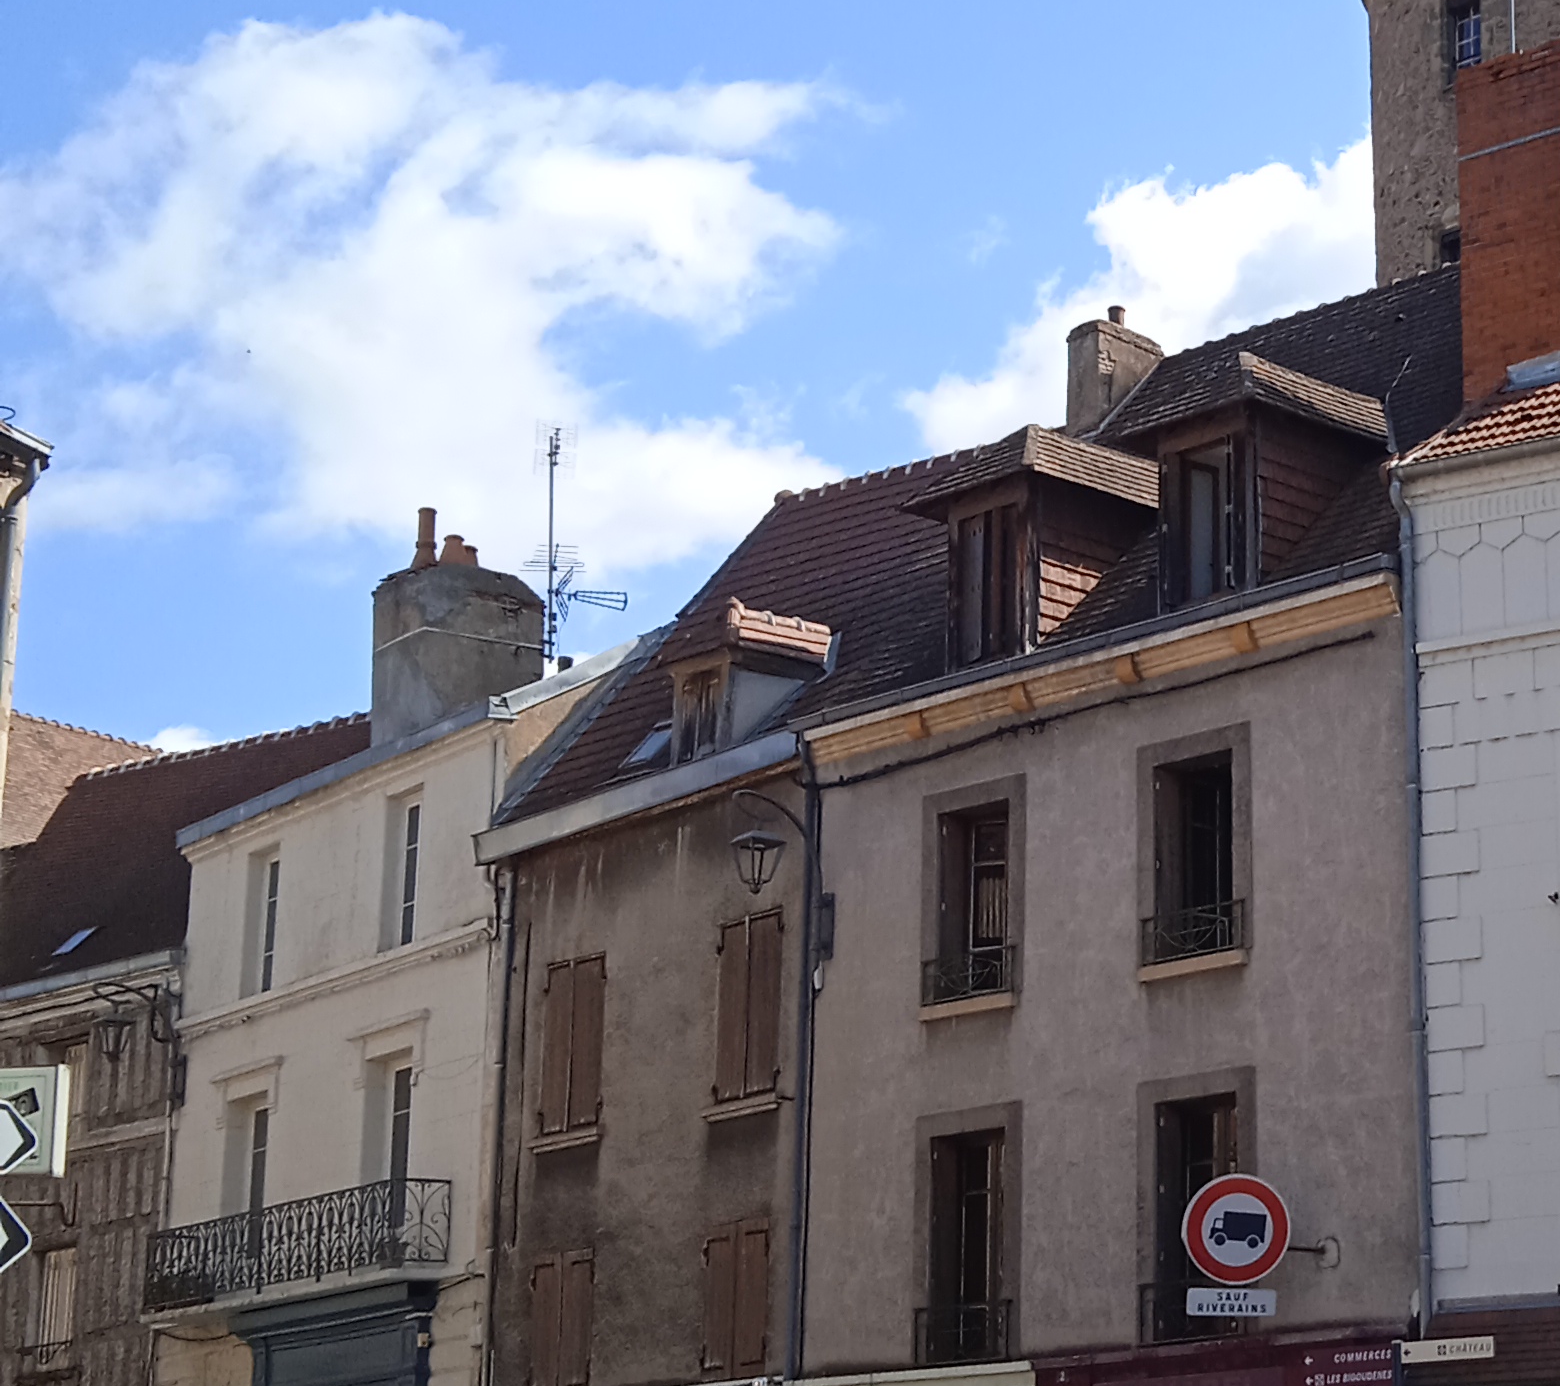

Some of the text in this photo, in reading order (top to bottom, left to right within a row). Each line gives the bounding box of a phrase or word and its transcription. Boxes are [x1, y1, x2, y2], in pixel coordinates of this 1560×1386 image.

[1217, 1292, 1249, 1302] SAUF
[1197, 1303, 1267, 1314] RIVERAINS
[1449, 1343, 1491, 1355] CHÂTEAU
[1334, 1349, 1392, 1363] COMMERCES
[1326, 1373, 1341, 1385] LES
